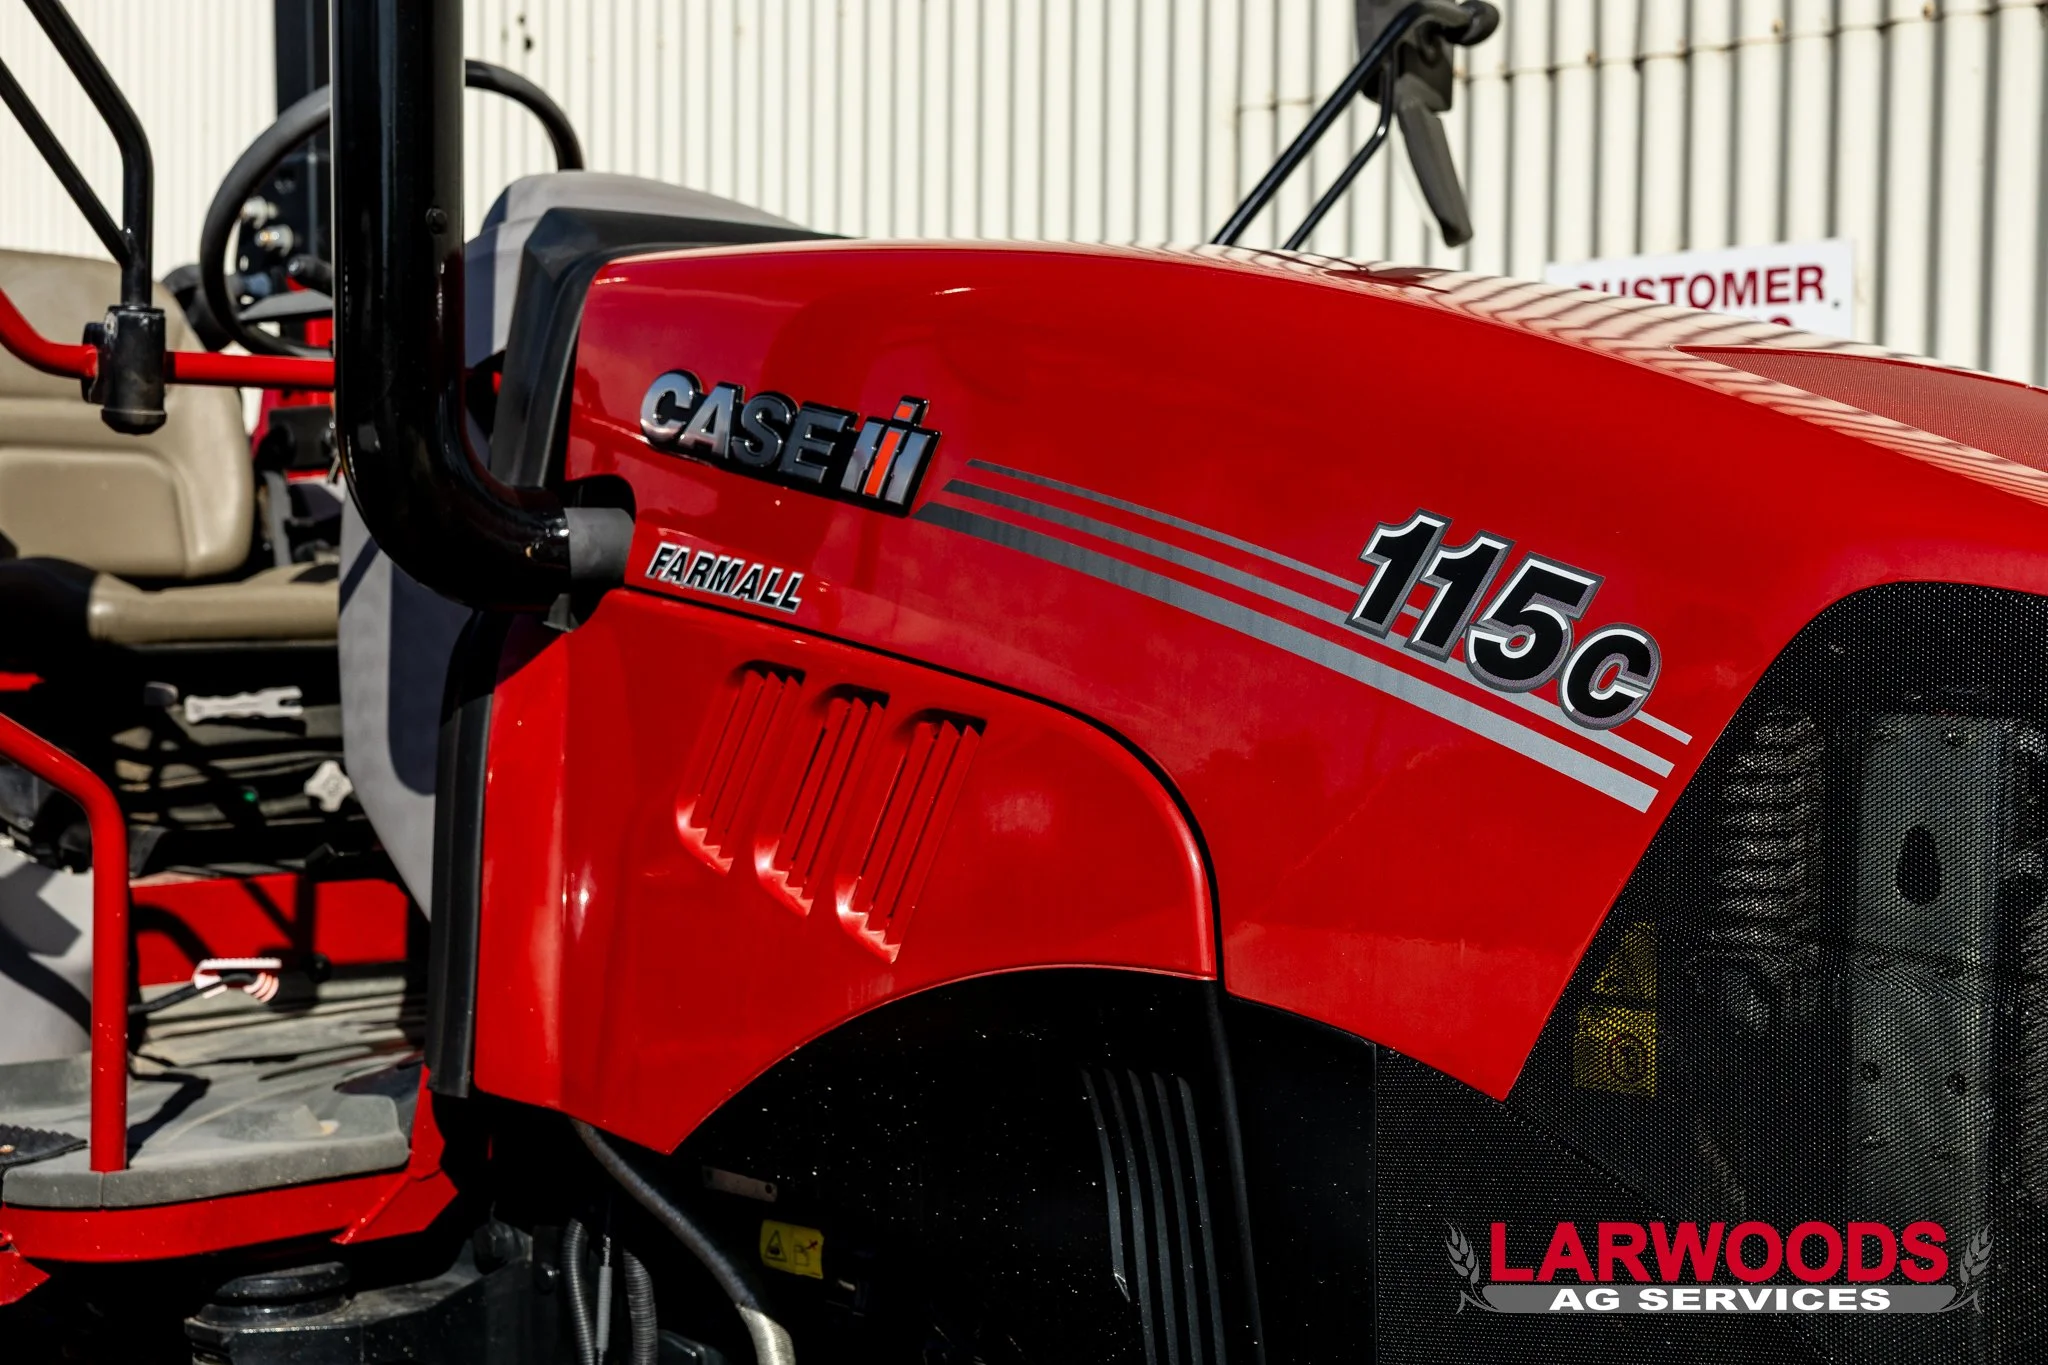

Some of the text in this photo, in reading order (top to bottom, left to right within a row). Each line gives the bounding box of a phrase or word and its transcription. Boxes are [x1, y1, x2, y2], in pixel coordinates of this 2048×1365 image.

[1577, 265, 1825, 310] STOMER
[640, 369, 858, 484] CASE
[645, 541, 804, 614] FARMALL
